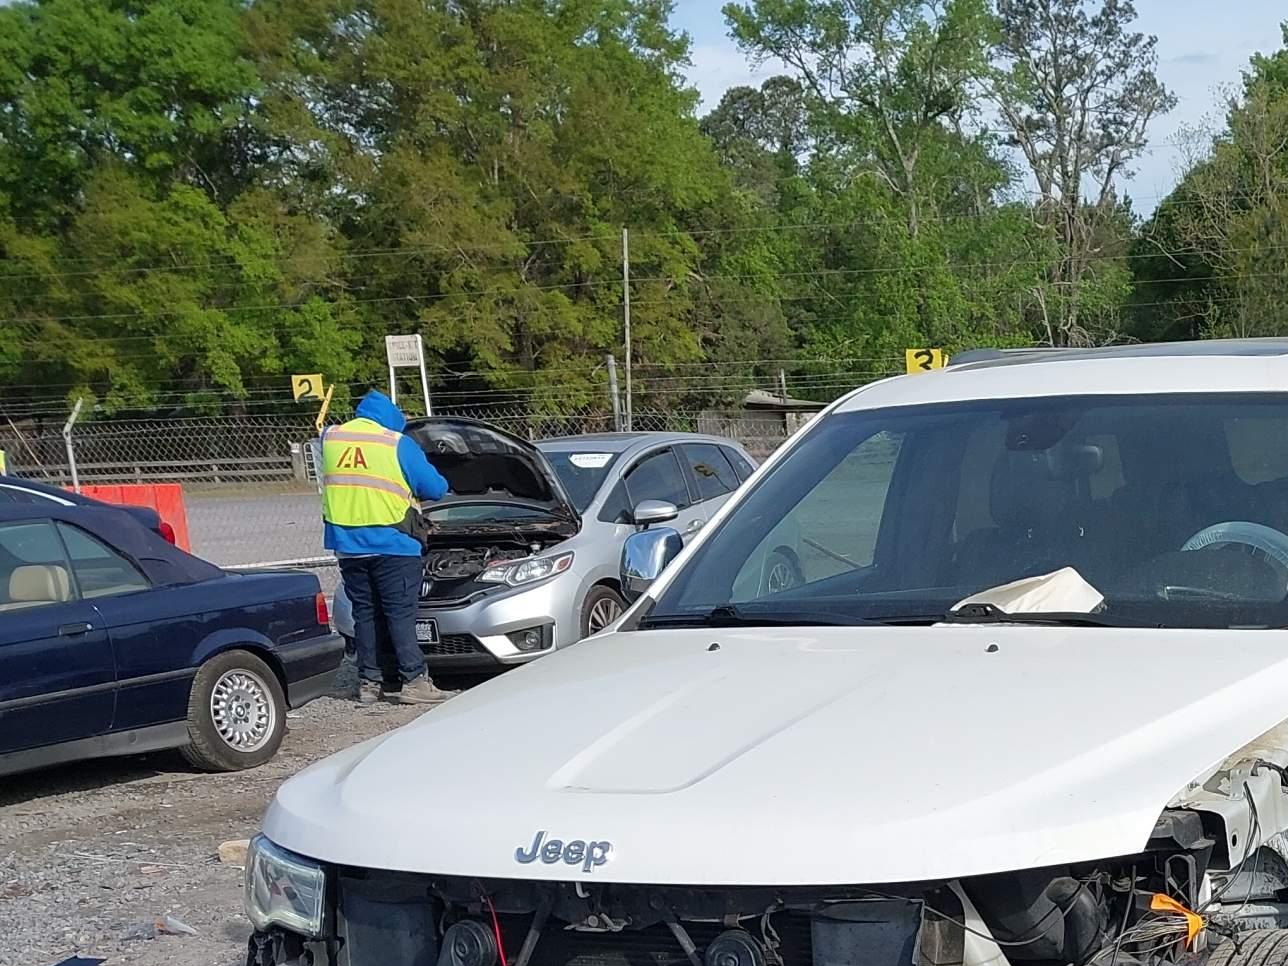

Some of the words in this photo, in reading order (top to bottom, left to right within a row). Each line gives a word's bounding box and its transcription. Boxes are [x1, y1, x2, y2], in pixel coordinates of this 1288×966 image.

[913, 349, 934, 372] 3
[297, 378, 320, 401] 2
[515, 830, 613, 873] Jeep
